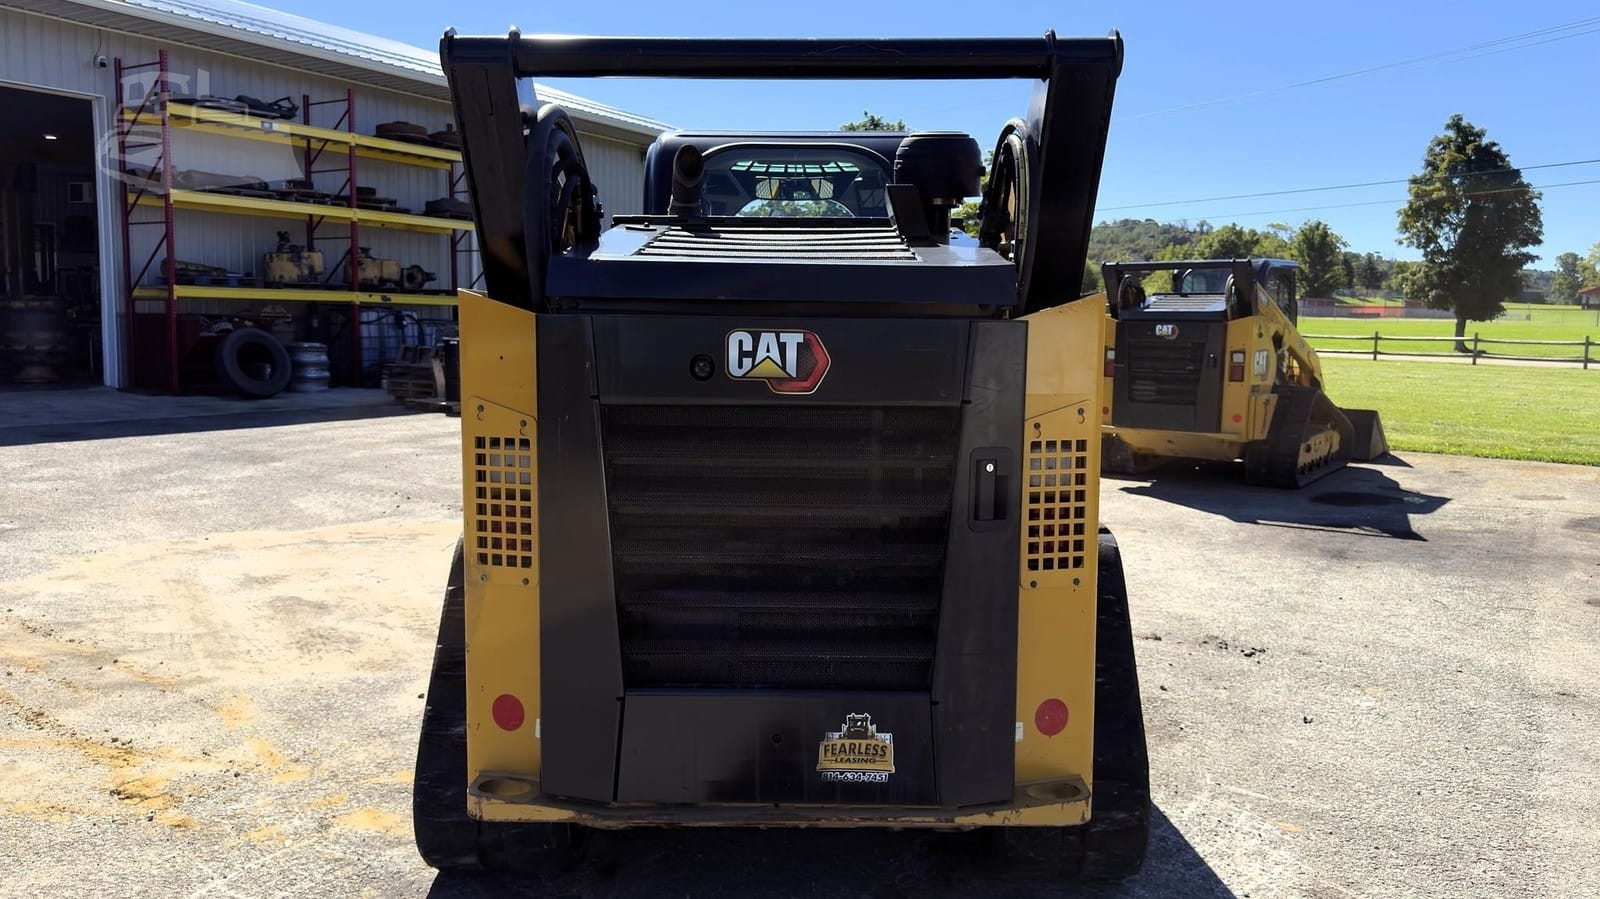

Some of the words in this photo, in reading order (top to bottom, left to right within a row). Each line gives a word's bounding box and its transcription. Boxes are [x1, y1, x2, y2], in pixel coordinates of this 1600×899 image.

[1155, 324, 1174, 336] CAT
[728, 331, 804, 378] CAT
[1254, 350, 1268, 376] CAT
[823, 741, 888, 758] FEARLESS
[822, 772, 889, 782] 814-634-7451
